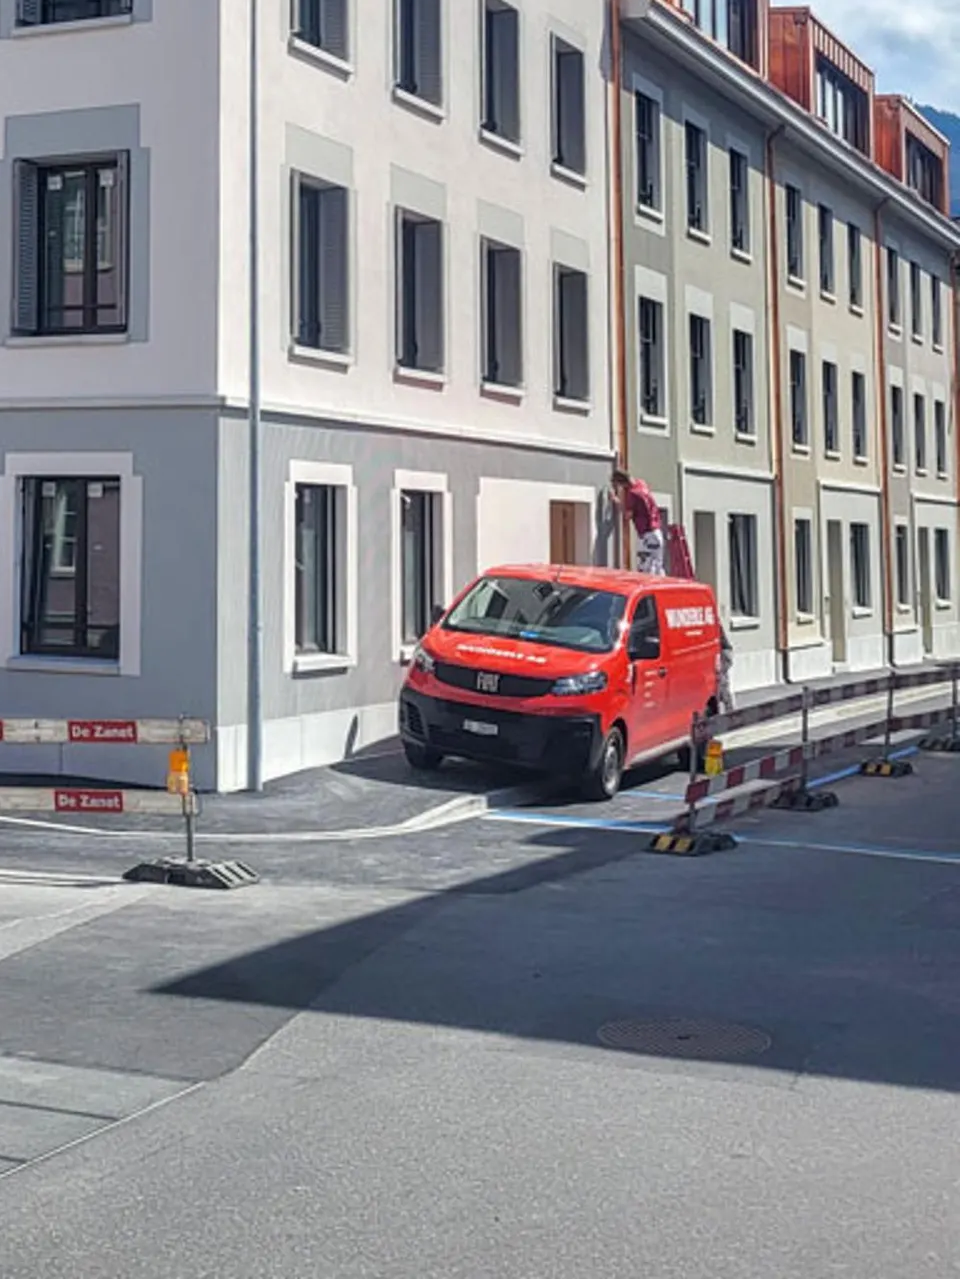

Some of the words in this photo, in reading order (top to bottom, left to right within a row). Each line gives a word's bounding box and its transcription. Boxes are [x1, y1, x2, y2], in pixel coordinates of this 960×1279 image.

[477, 671, 499, 693] FIAT
[72, 726, 90, 737] De
[93, 727, 133, 738] Zanet
[58, 795, 76, 806] De
[80, 796, 121, 808] Zanet
